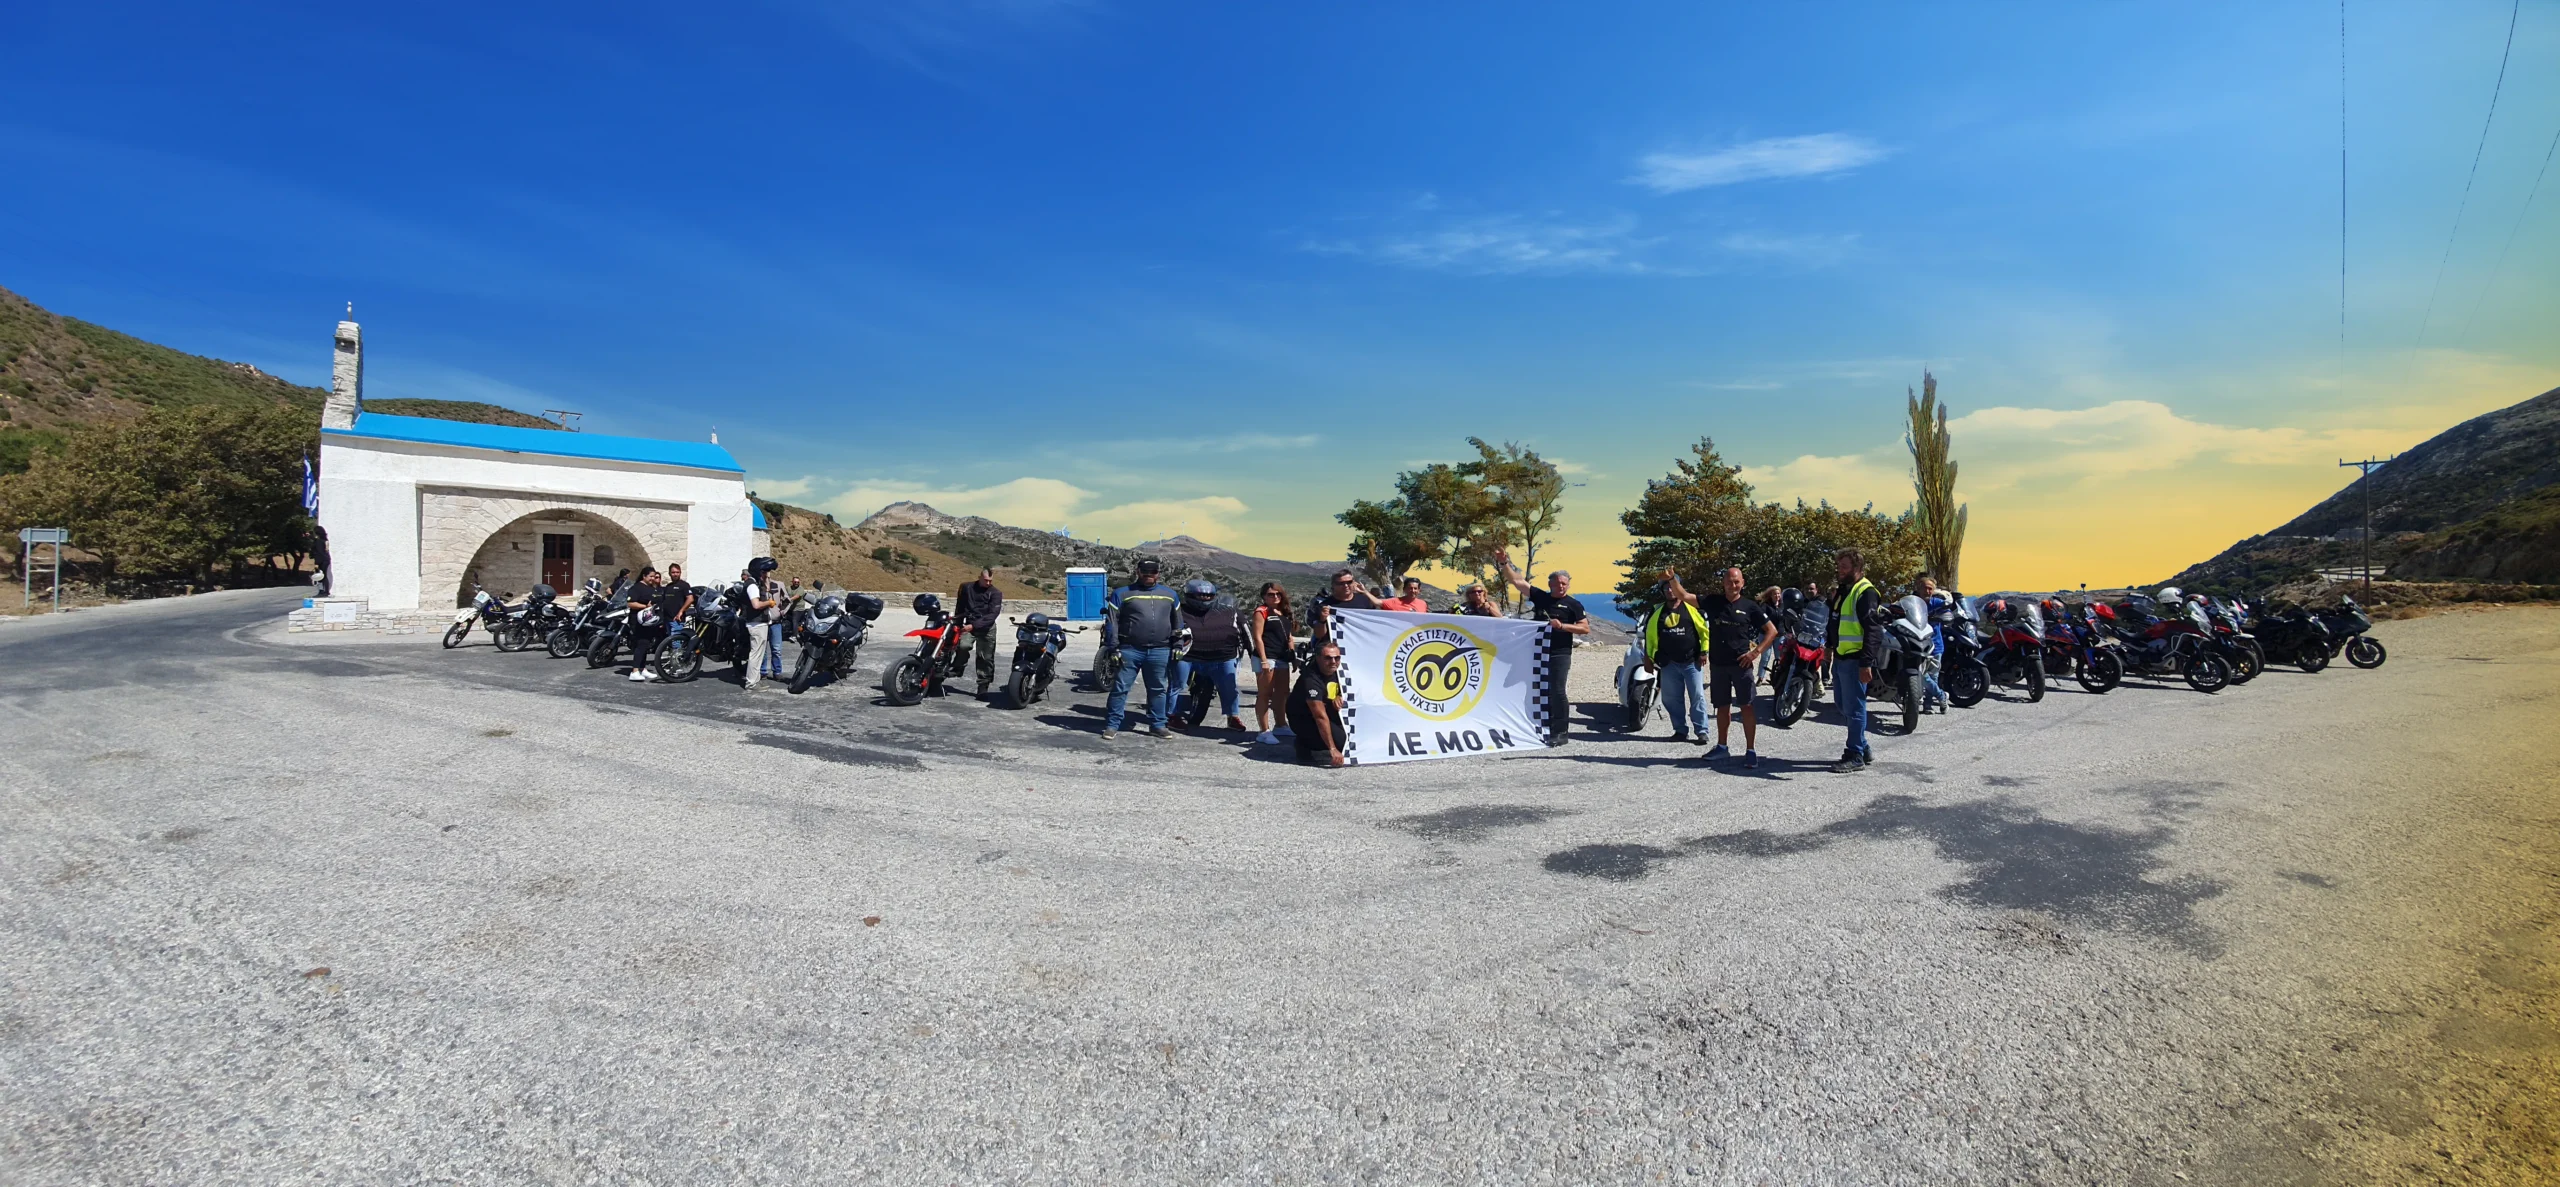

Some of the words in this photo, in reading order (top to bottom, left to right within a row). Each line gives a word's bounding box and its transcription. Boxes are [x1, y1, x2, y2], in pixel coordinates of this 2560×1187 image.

[1393, 629, 1467, 694] ΜΟΤΟΣΥΚΛΕΤΙΣΤΩΝ
[1467, 652, 1481, 691] ΝΑΞΟΥ
[1409, 694, 1445, 713] ΛΕΣΧΗ
